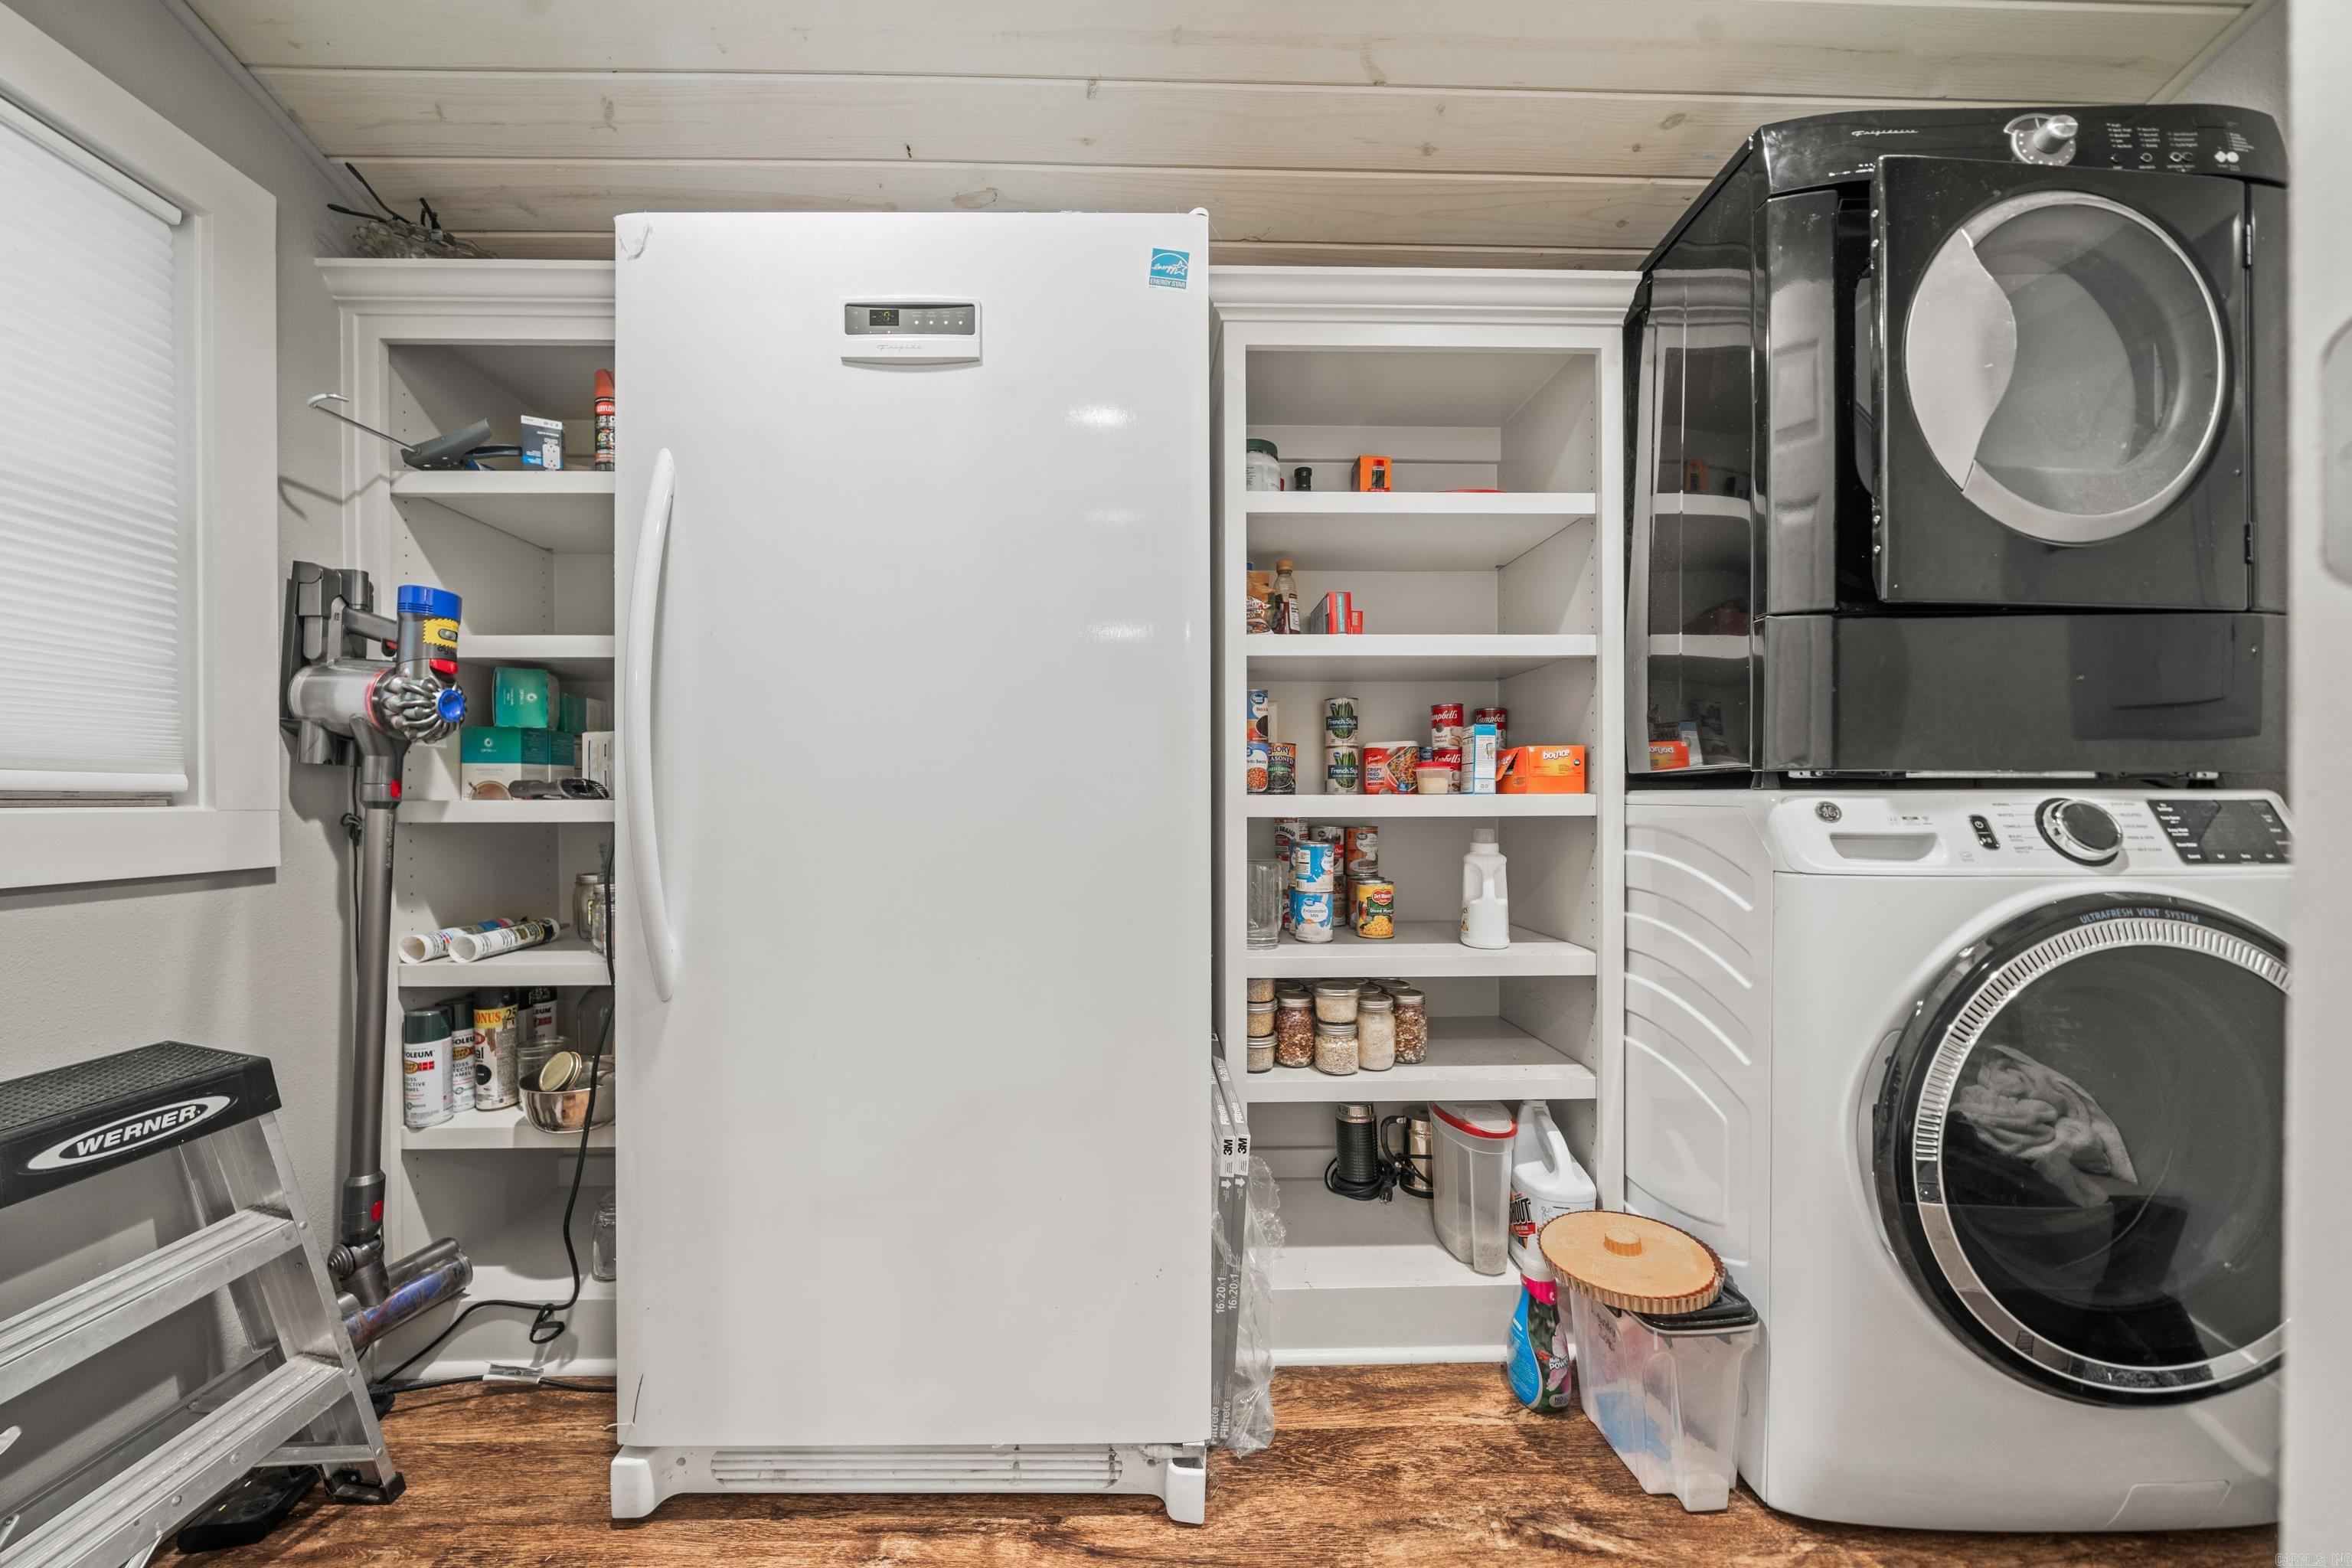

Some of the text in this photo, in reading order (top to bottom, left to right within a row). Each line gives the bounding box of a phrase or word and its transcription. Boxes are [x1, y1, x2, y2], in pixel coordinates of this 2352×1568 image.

[1150, 278, 1171, 286] ENERGY
[1542, 749, 1571, 760] bounce
[2079, 908, 2200, 924] ULTRAFRESH VENT SYSTEM
[475, 1011, 501, 1024] ONUS
[1217, 1105, 1230, 1125] Filtrete
[1232, 1102, 1245, 1124] Filtrete
[77, 1105, 197, 1157] WERNER
[1223, 1139, 1233, 1155] 3M
[1237, 1138, 1248, 1154] 3M
[1215, 1276, 1227, 1313] 16x20x1
[1228, 1273, 1239, 1310] 16x20x1
[1220, 1401, 1231, 1439] Filtrete
